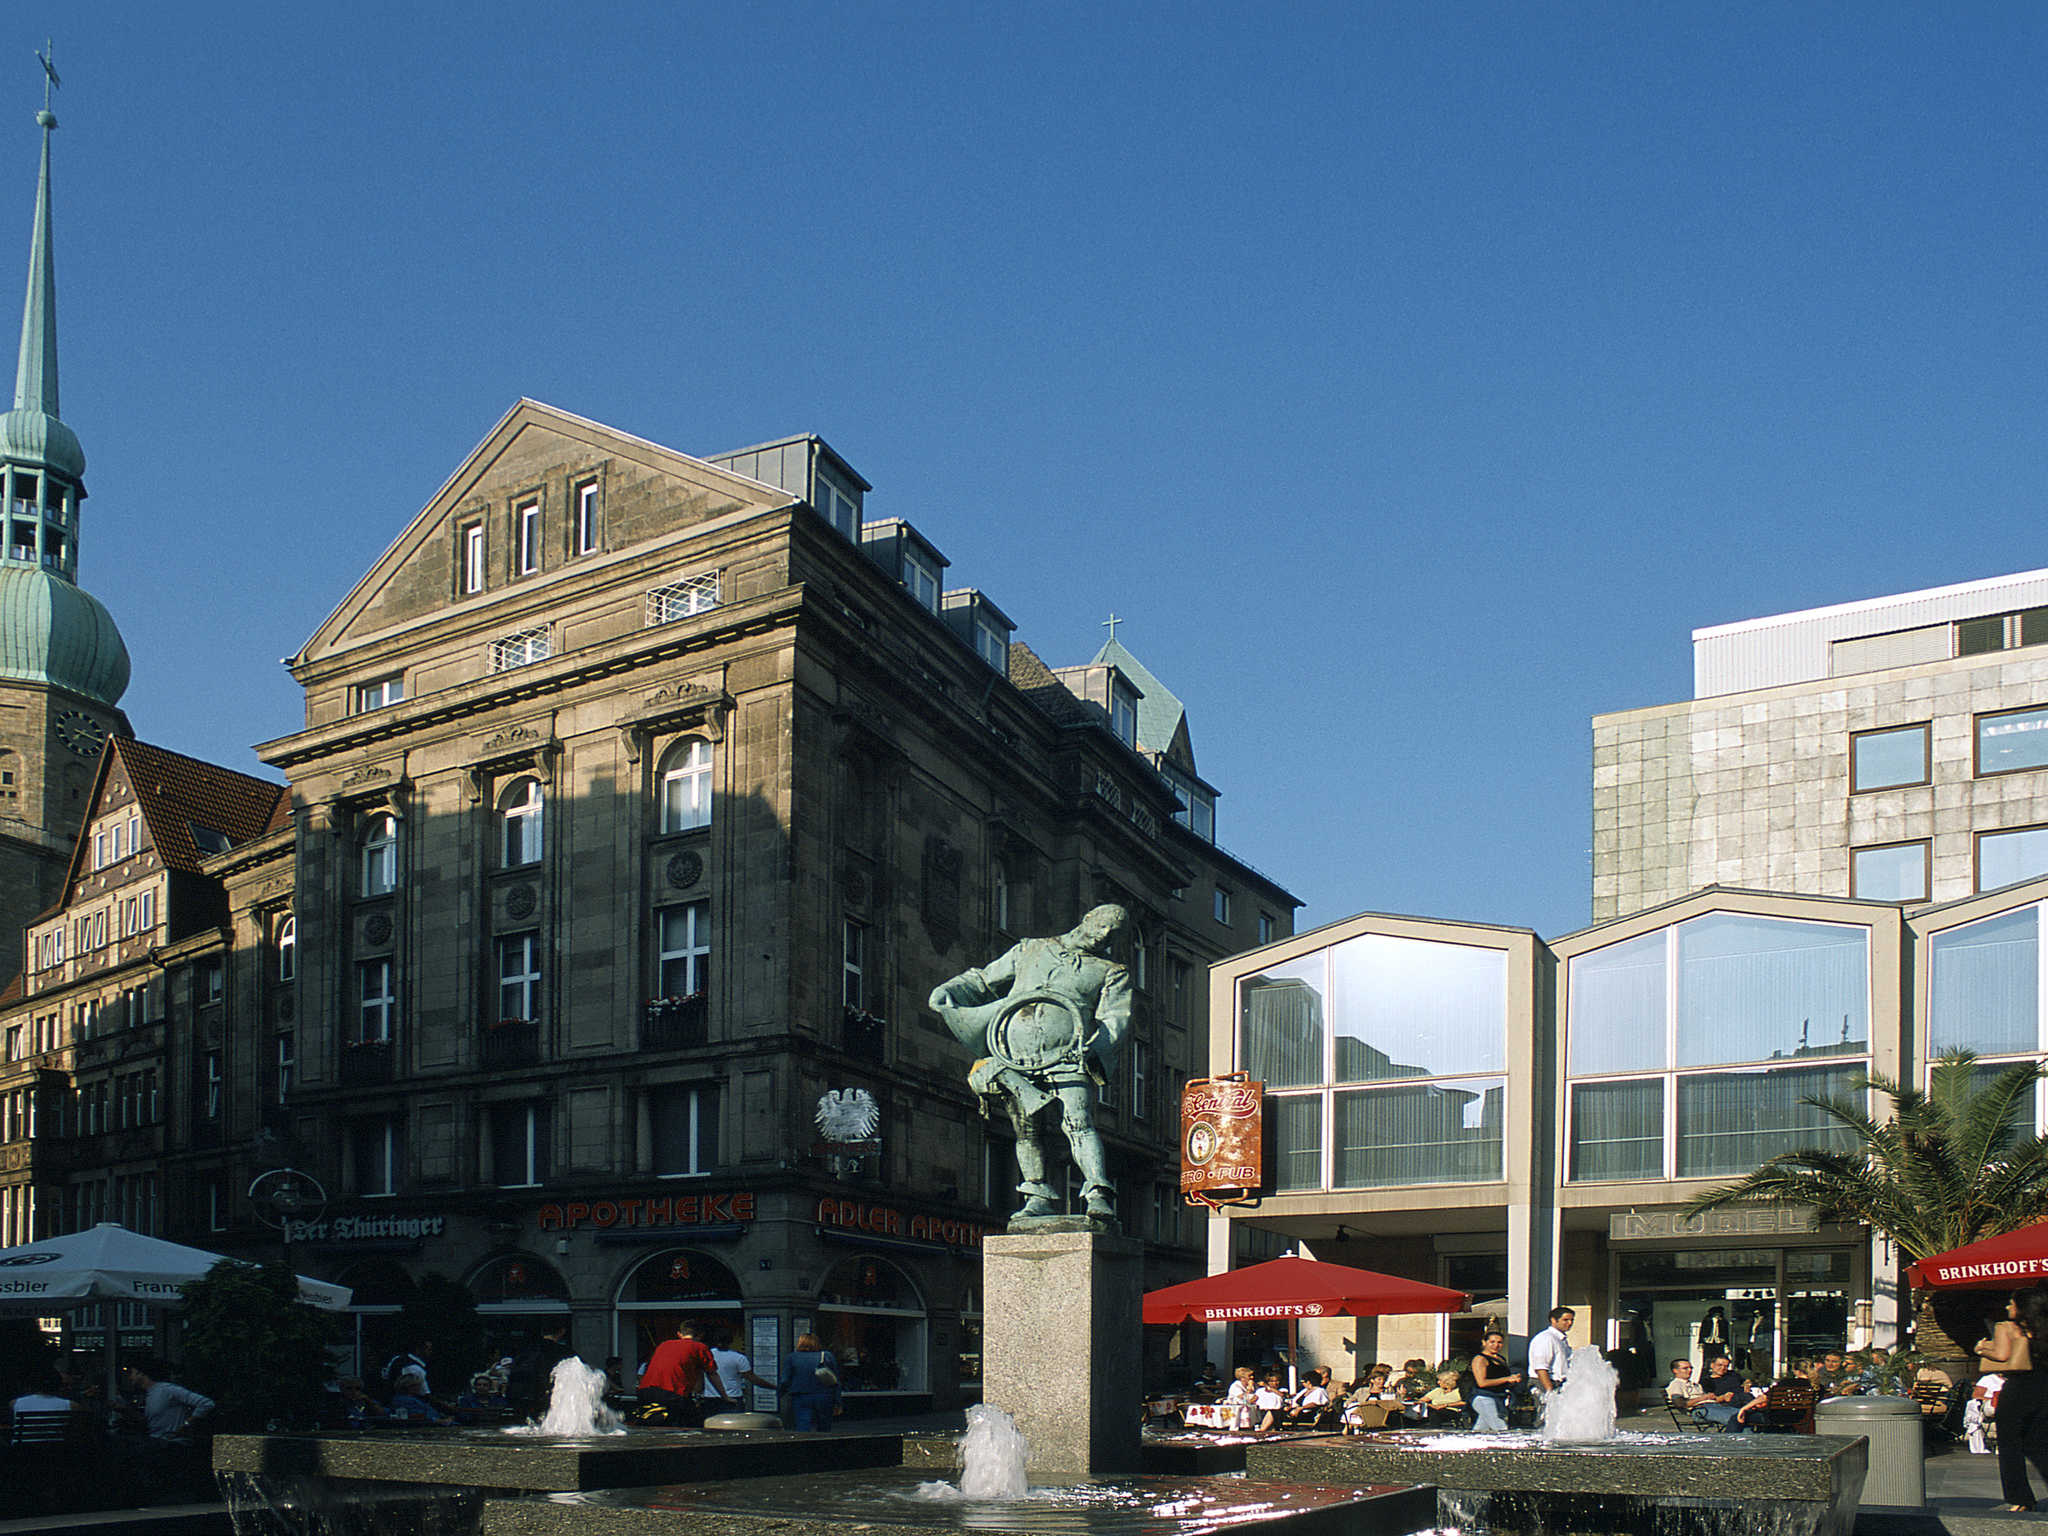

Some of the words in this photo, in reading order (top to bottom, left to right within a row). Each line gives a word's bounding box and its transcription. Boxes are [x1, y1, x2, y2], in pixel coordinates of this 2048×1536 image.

[1218, 1166, 1255, 1180] PUB
[539, 1192, 754, 1229] APOTHEKE
[292, 1218, 328, 1240] Der
[336, 1215, 445, 1240] Thüringer
[816, 1197, 900, 1235] ADLER
[912, 1215, 985, 1248] APOTH
[1938, 1258, 2048, 1280] BRINKHOFF'S
[1205, 1304, 1303, 1319] BRINKHOFF'S
